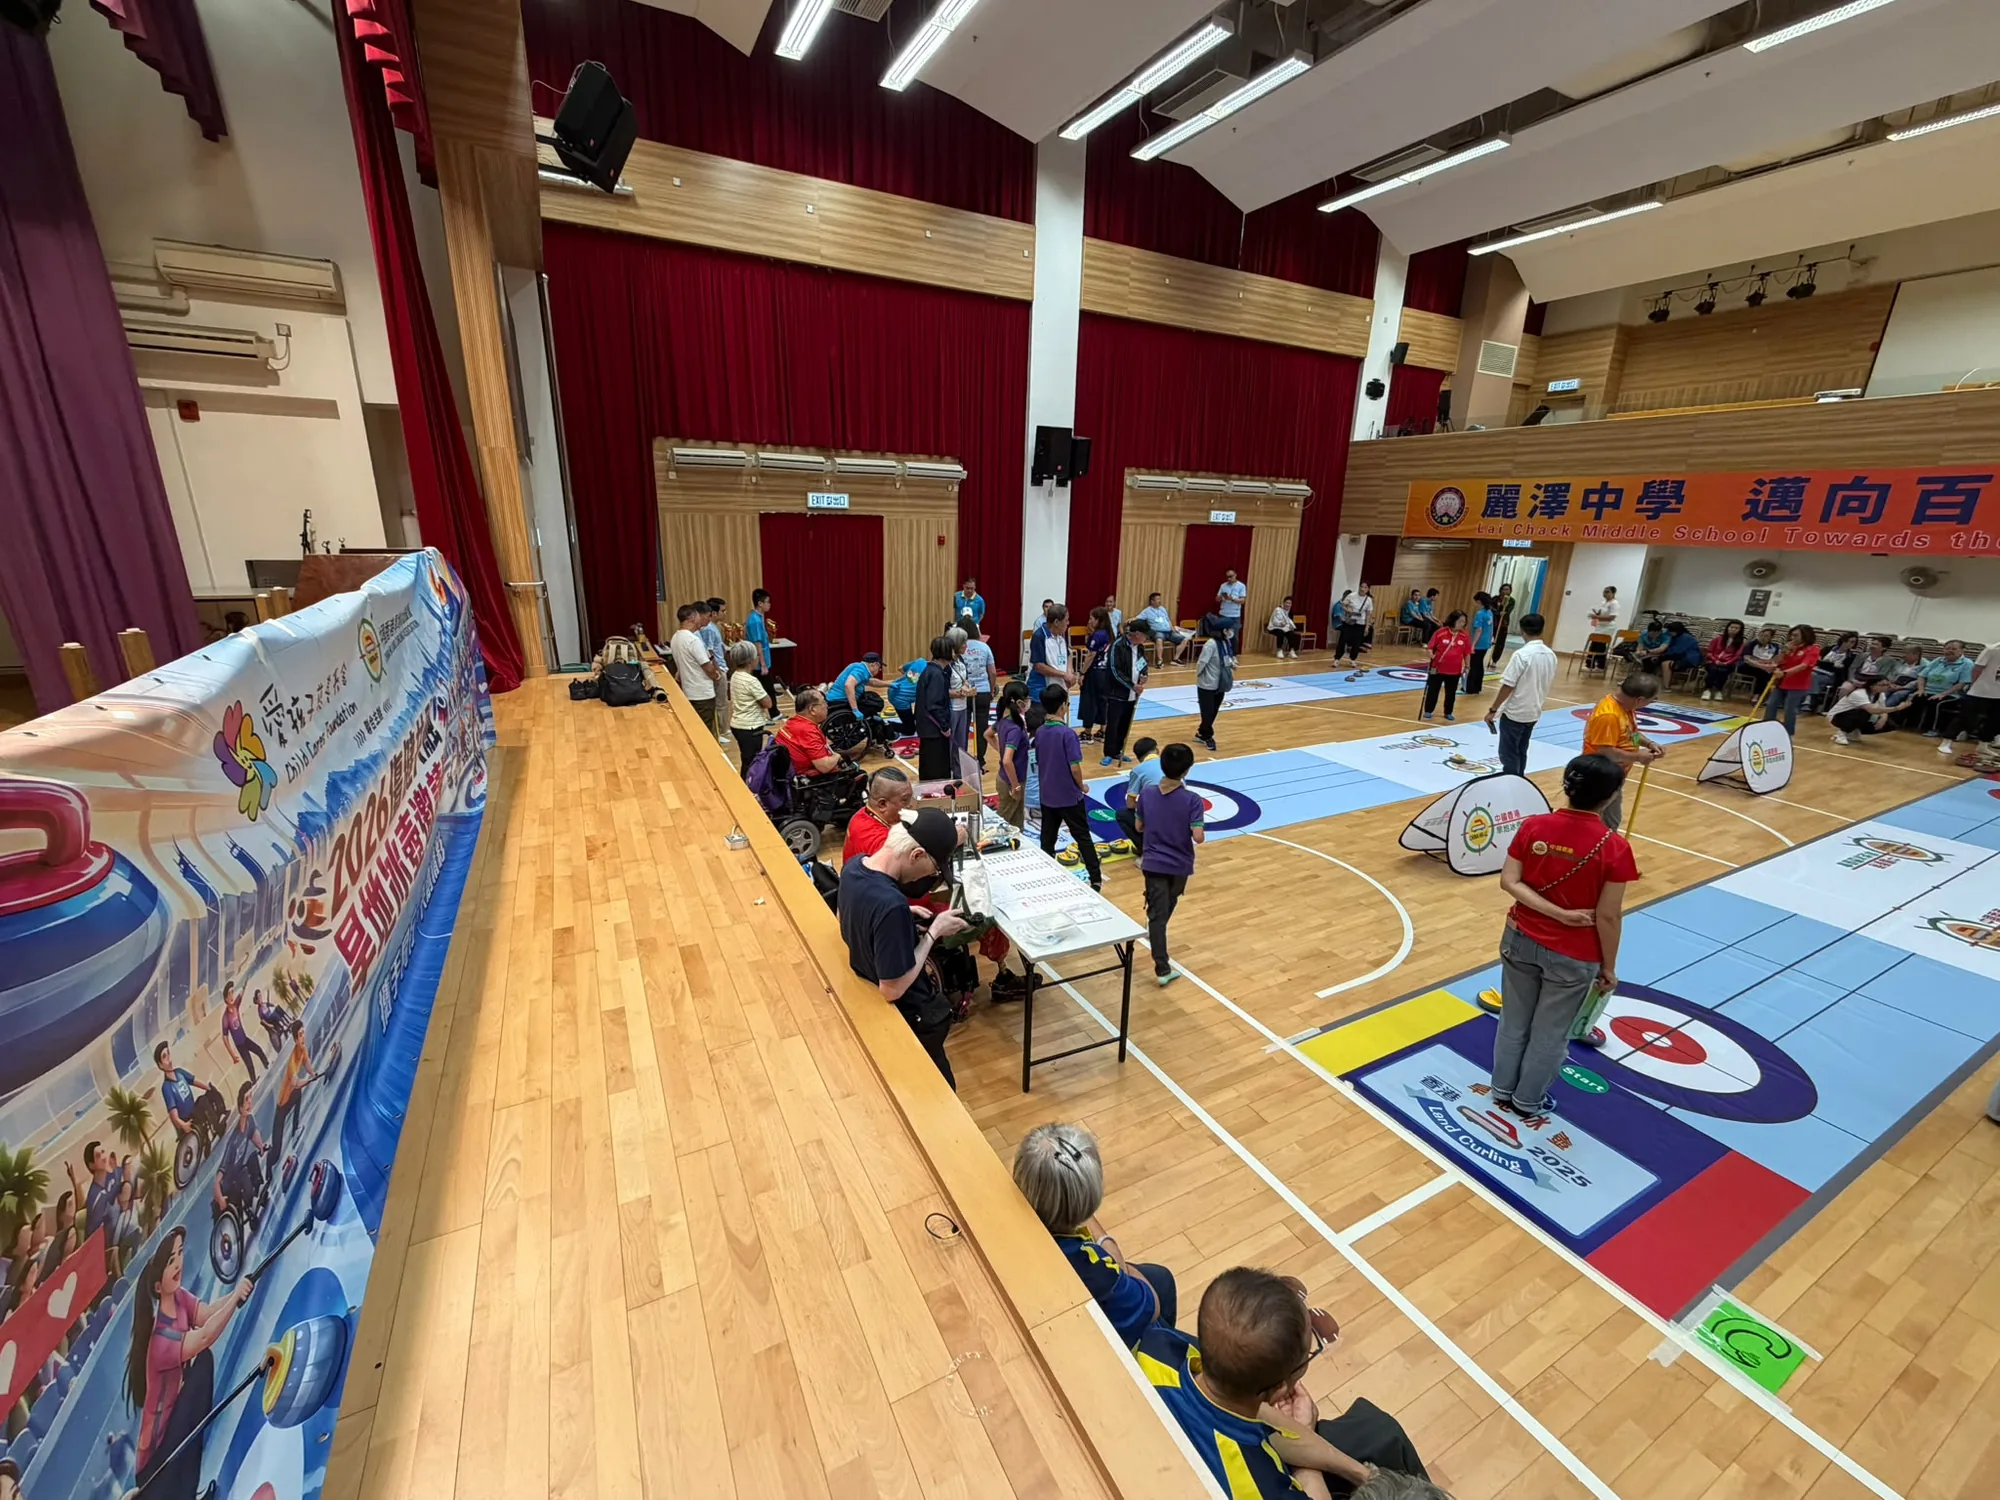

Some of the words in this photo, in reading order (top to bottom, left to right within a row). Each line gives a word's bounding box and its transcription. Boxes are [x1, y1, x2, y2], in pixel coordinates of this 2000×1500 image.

[811, 494, 825, 505] EXIT
[1481, 479, 1686, 521] 麗澤中學
[1740, 474, 1994, 526] 邁向百
[1476, 523, 1504, 535] Lai
[1513, 524, 1571, 537] Chack
[1582, 525, 1661, 540] Middle
[1673, 526, 1768, 542] School
[1785, 527, 1931, 547] Towards
[1419, 1075, 1462, 1103] 香港
[1562, 1066, 1605, 1093] Start
[1428, 1105, 1462, 1134] Land
[1457, 1132, 1525, 1175] Curling
[1526, 1146, 1594, 1188] 2025
